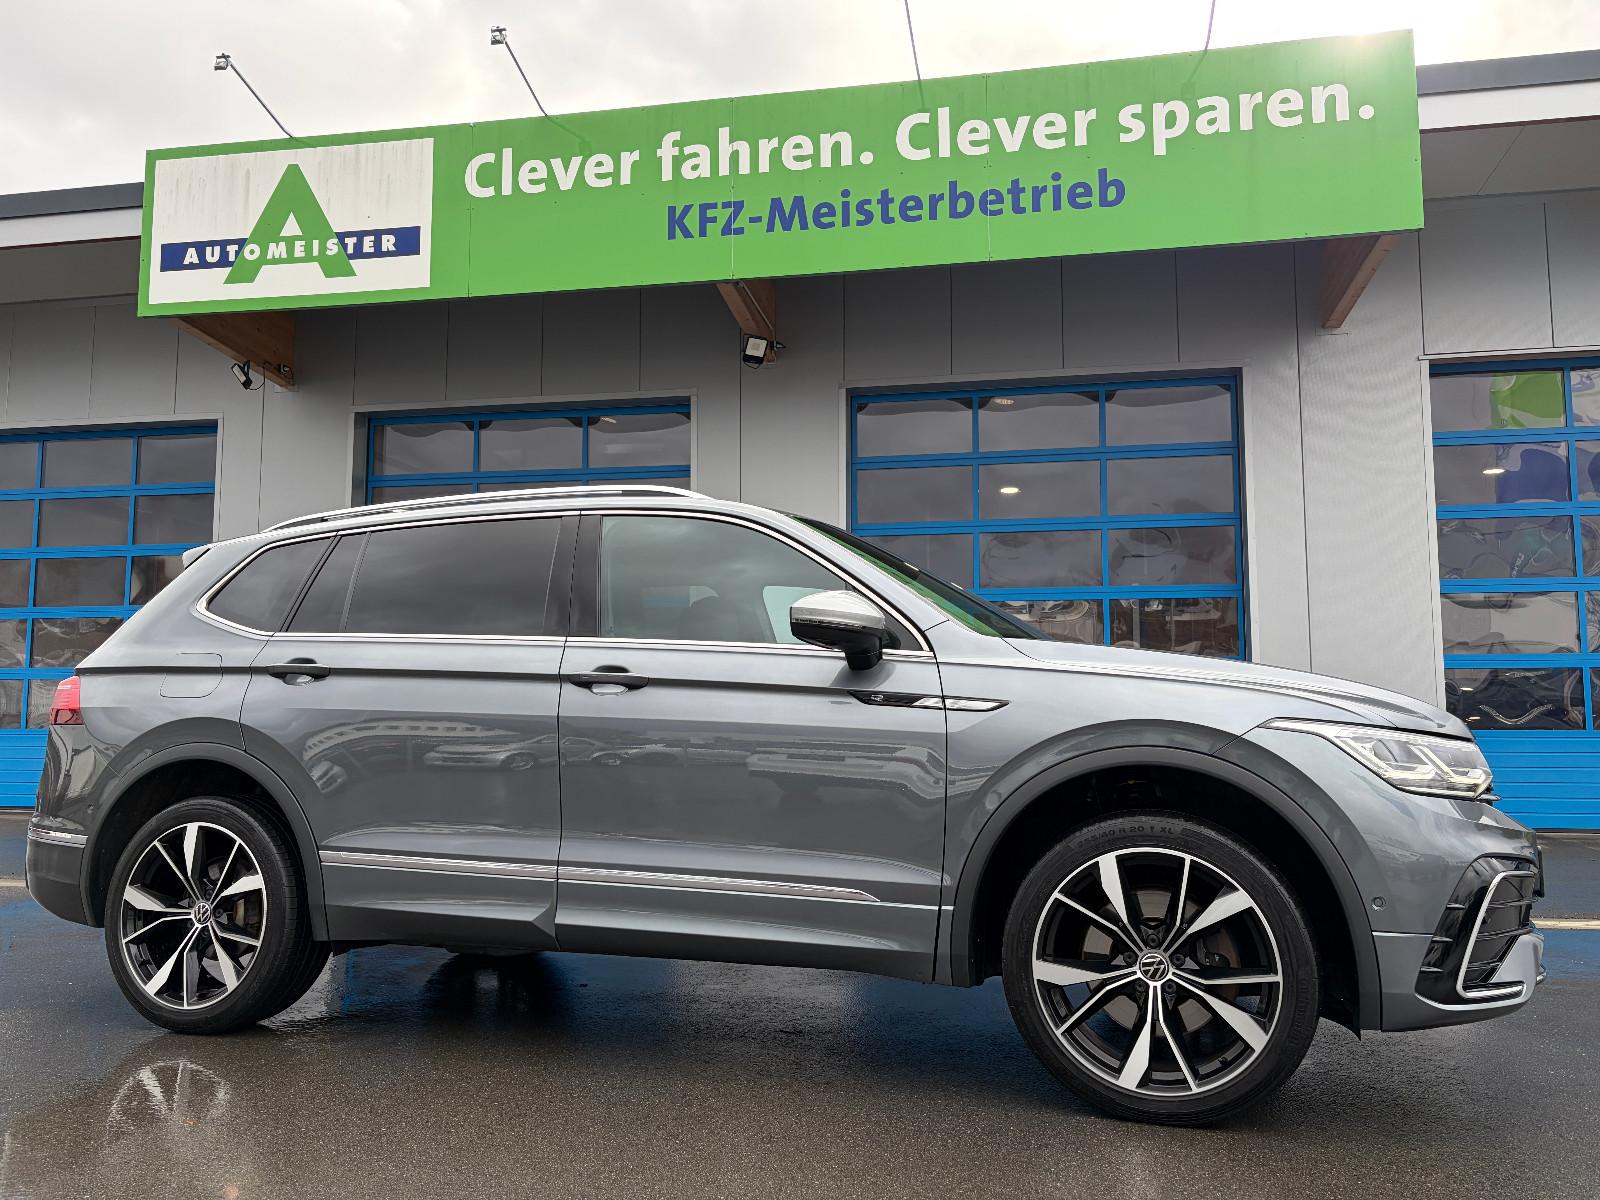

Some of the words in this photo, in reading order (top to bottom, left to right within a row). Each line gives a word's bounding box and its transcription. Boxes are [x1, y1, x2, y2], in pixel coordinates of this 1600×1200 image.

[465, 148, 640, 198] Clever
[657, 127, 874, 181] fahren.
[896, 106, 1097, 160] Clever
[1118, 82, 1375, 156] sparen.
[668, 169, 1125, 240] KFZ-Meisterbetrieb
[183, 234, 397, 264] AUTOMEISTER
